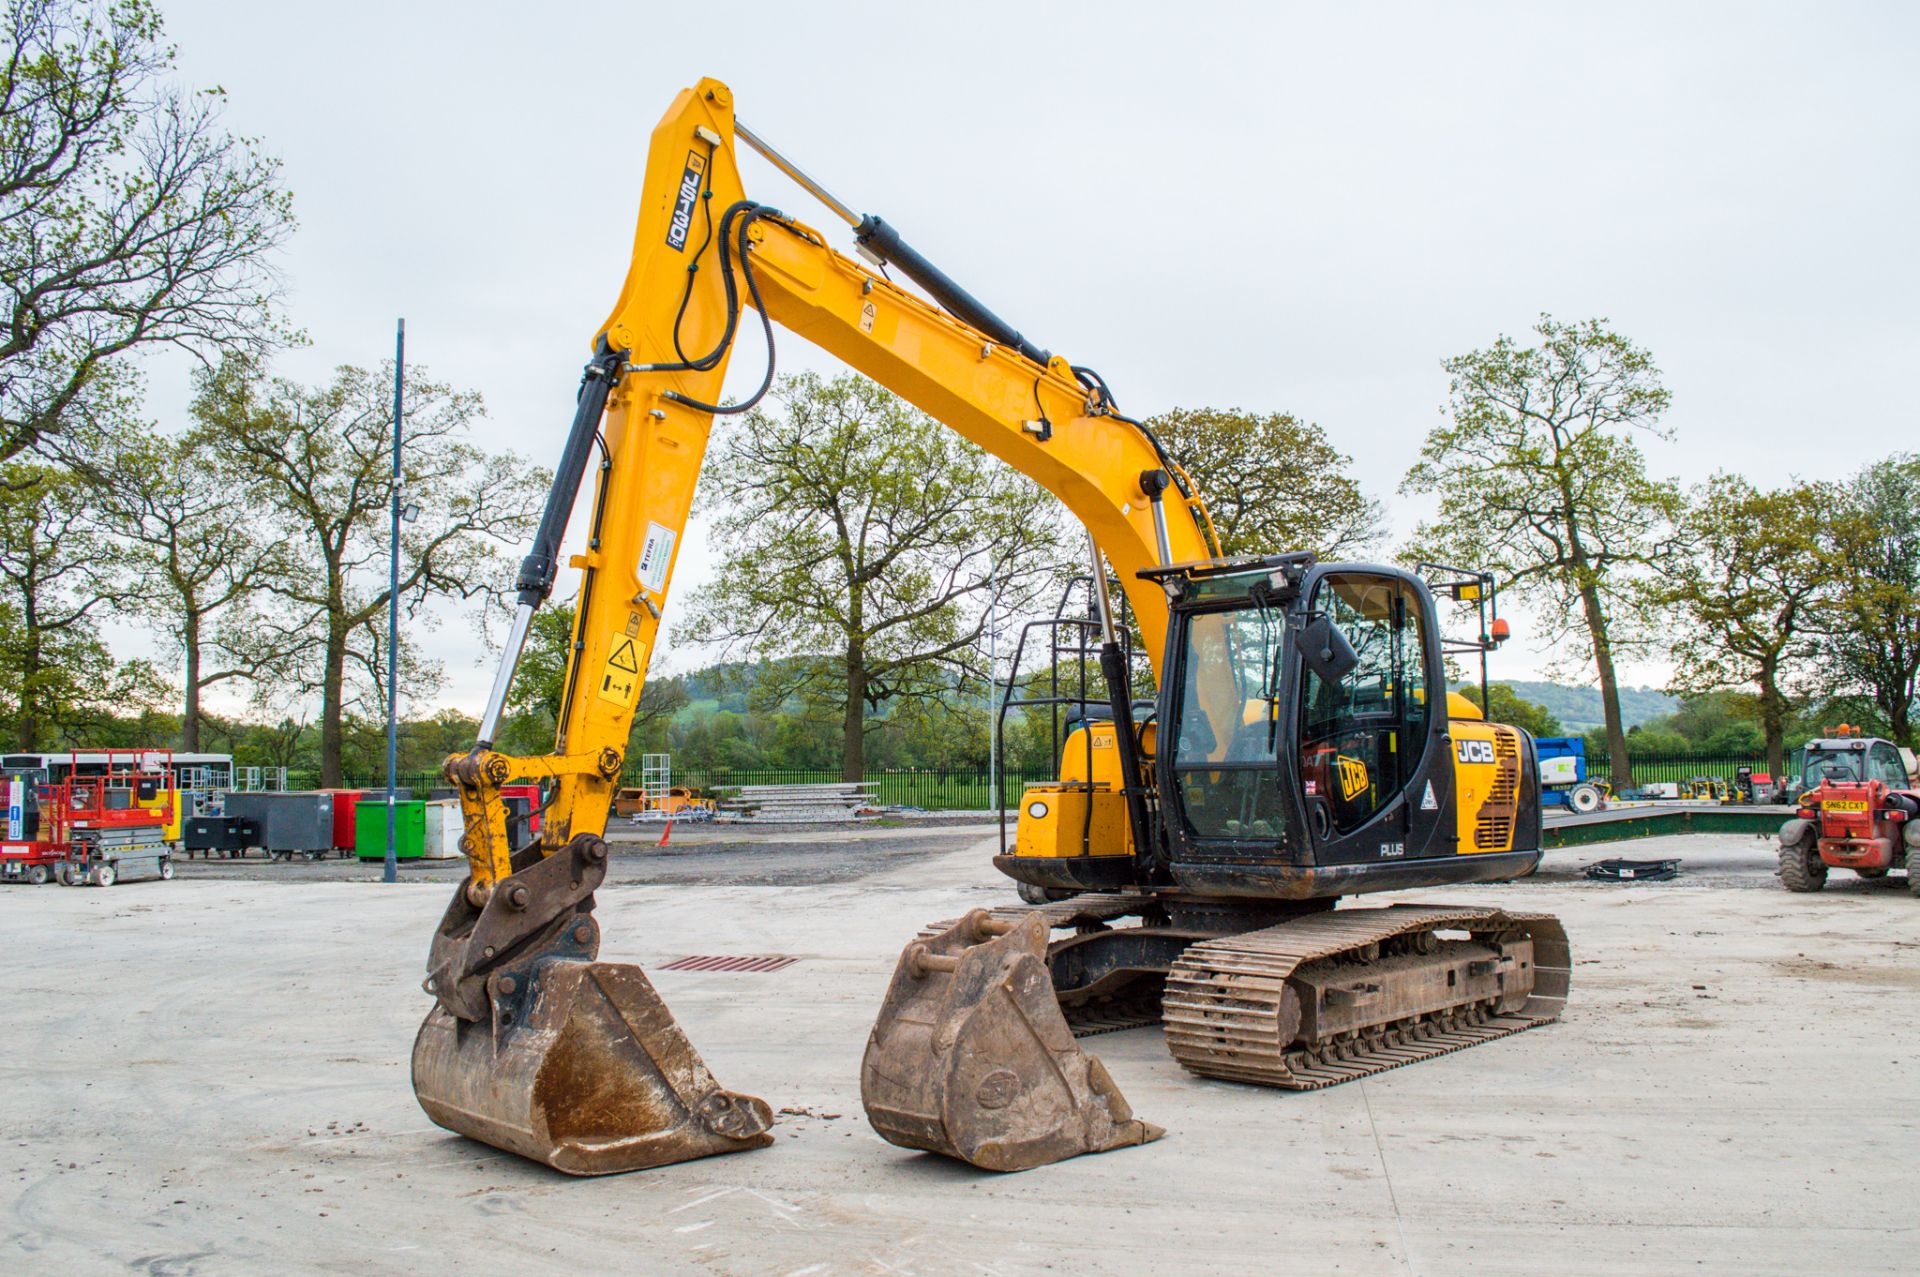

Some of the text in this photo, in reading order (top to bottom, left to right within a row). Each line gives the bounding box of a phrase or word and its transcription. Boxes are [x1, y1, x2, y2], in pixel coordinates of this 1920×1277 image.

[670, 173, 700, 243] JS130
[1455, 740, 1495, 762] JCB
[1343, 760, 1367, 796] JCB
[1381, 843, 1404, 856] PLUS
